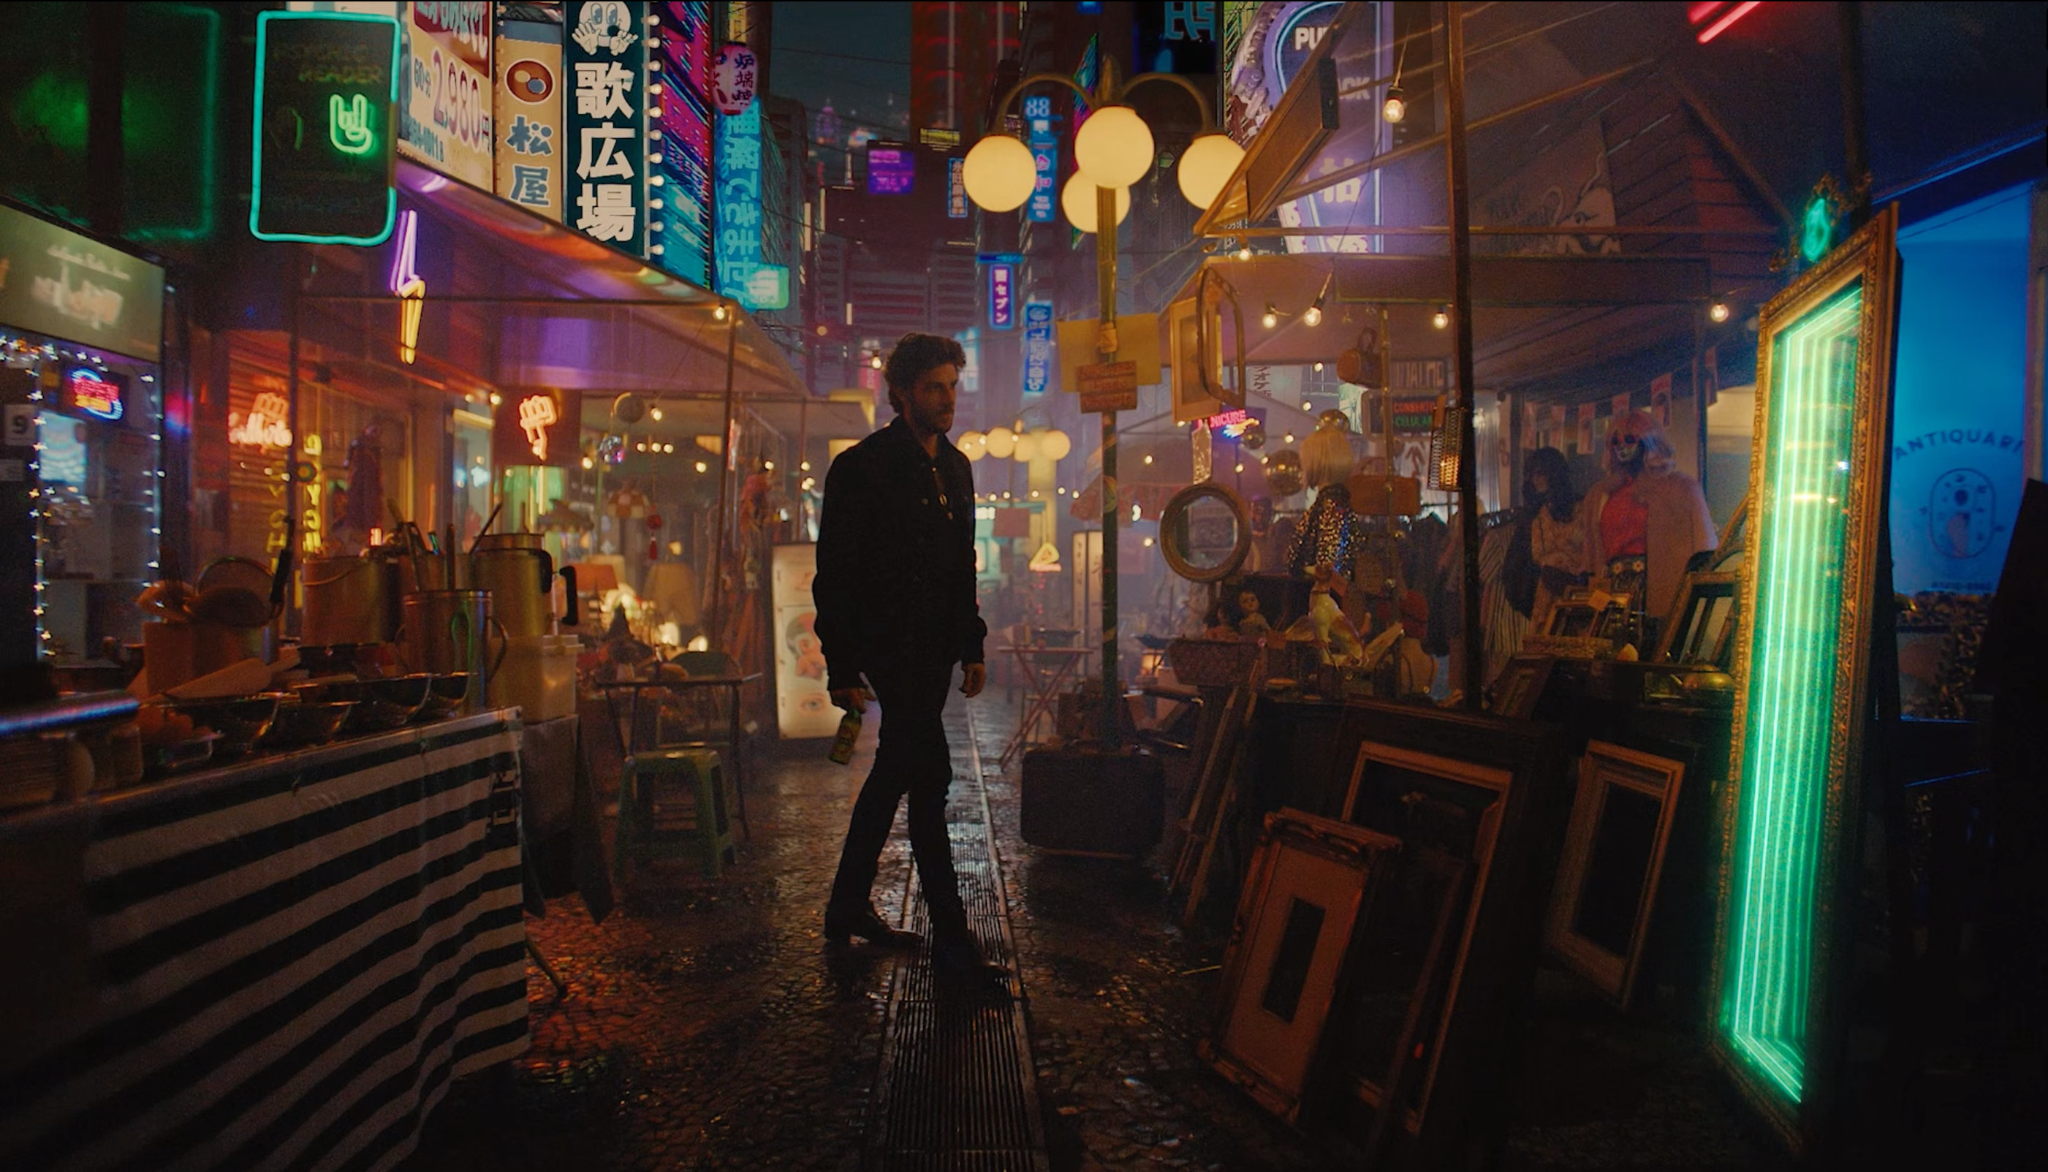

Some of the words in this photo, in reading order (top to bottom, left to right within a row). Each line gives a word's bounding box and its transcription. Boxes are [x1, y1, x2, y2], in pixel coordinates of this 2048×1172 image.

[506, 115, 554, 207] 松屋
[575, 61, 636, 242] 歌広場
